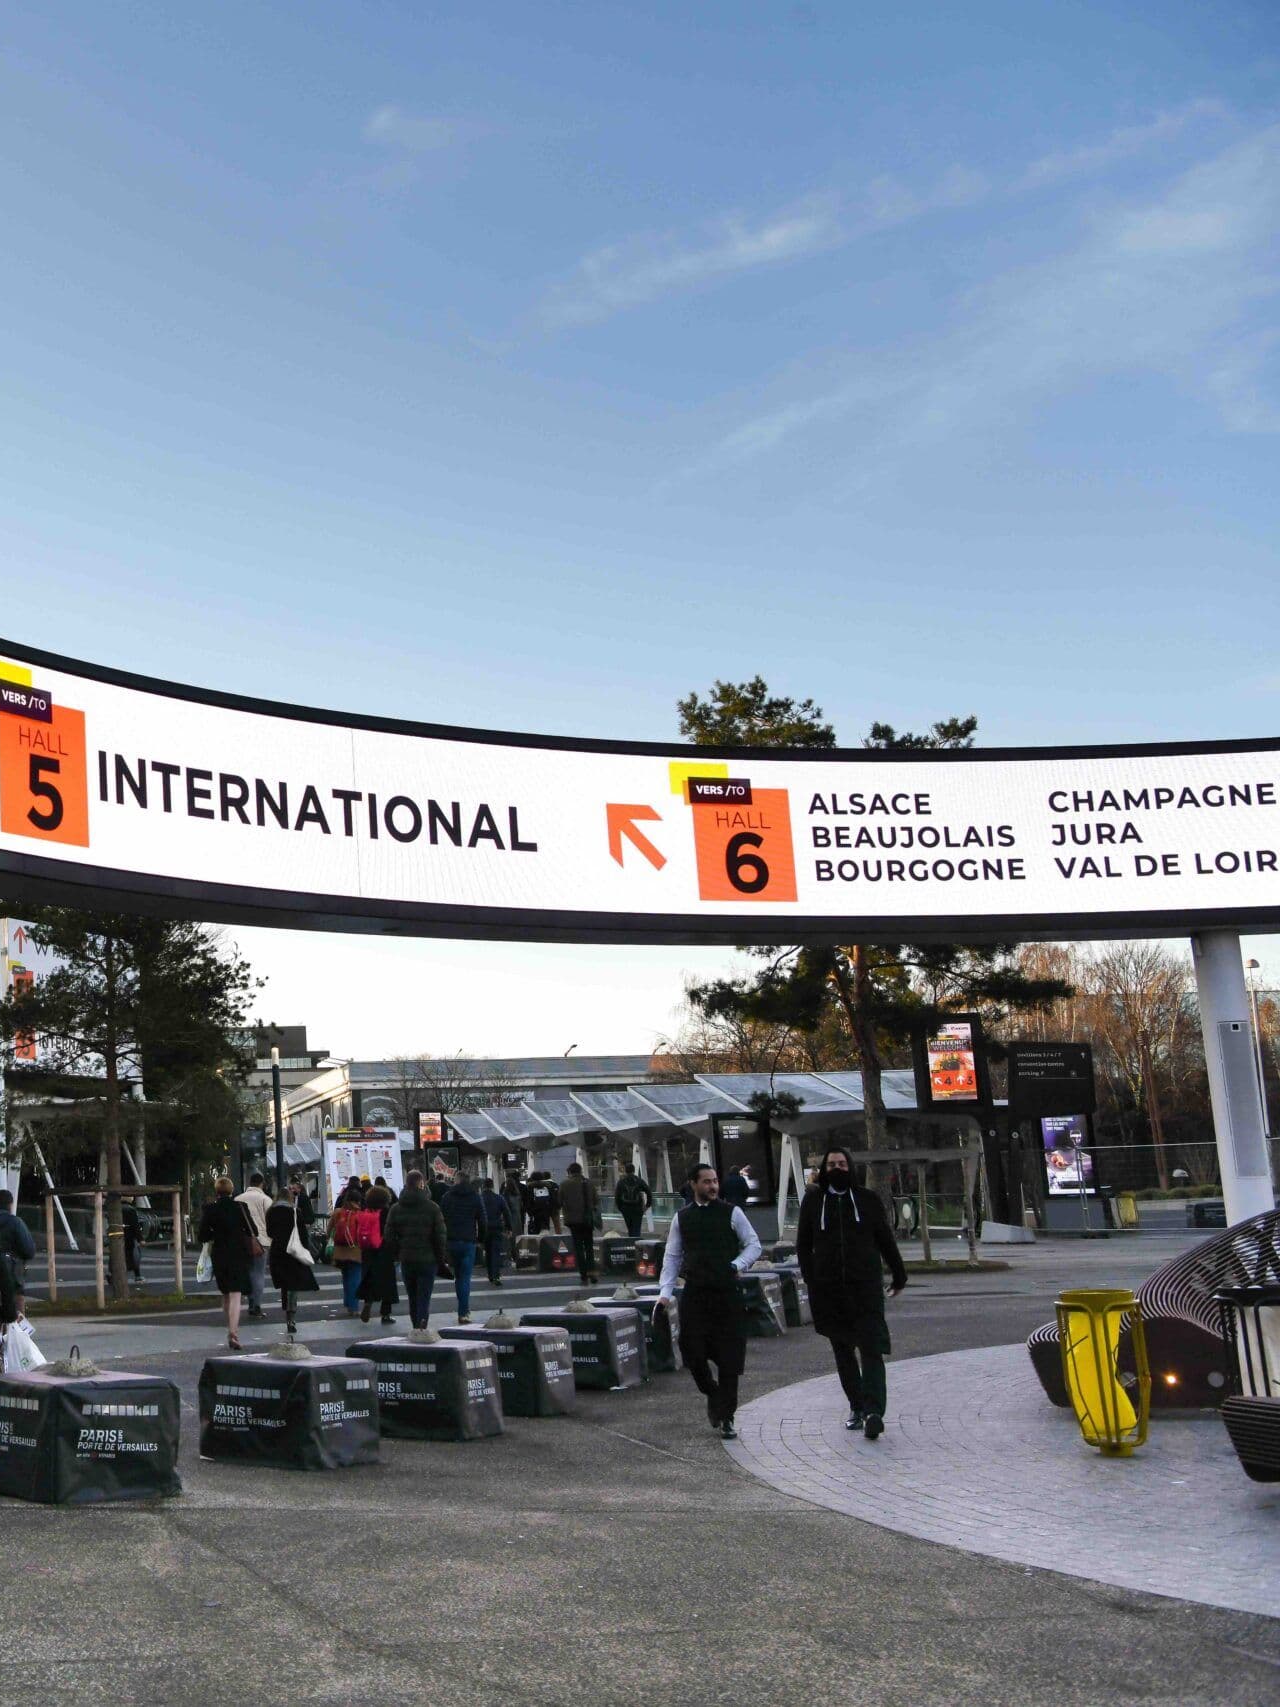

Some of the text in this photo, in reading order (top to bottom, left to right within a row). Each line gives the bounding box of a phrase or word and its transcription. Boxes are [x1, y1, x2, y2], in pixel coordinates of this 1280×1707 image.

[1, 689, 27, 706] VERS
[19, 725, 69, 756] HALL
[27, 753, 64, 832] 5
[97, 750, 538, 853] INTERNATIONAL
[695, 785, 724, 796] VERS
[1048, 783, 1277, 813] CHAMPAGNE
[808, 793, 932, 815] ALSACE
[715, 811, 772, 829] HALL
[811, 825, 1016, 848] BEAUJOLAIS
[1051, 822, 1144, 846] JURA
[725, 831, 770, 894] 6
[815, 858, 1027, 882] BOURGOGNE
[1054, 850, 1279, 879] VAL DE LOIR
[377, 1382, 396, 1393] RIS
[214, 1404, 246, 1419] PARIS
[320, 1402, 341, 1415] PARIS
[77, 1441, 159, 1452] PORTE DE VERSAILLES
[79, 1429, 118, 1444] PARIS
